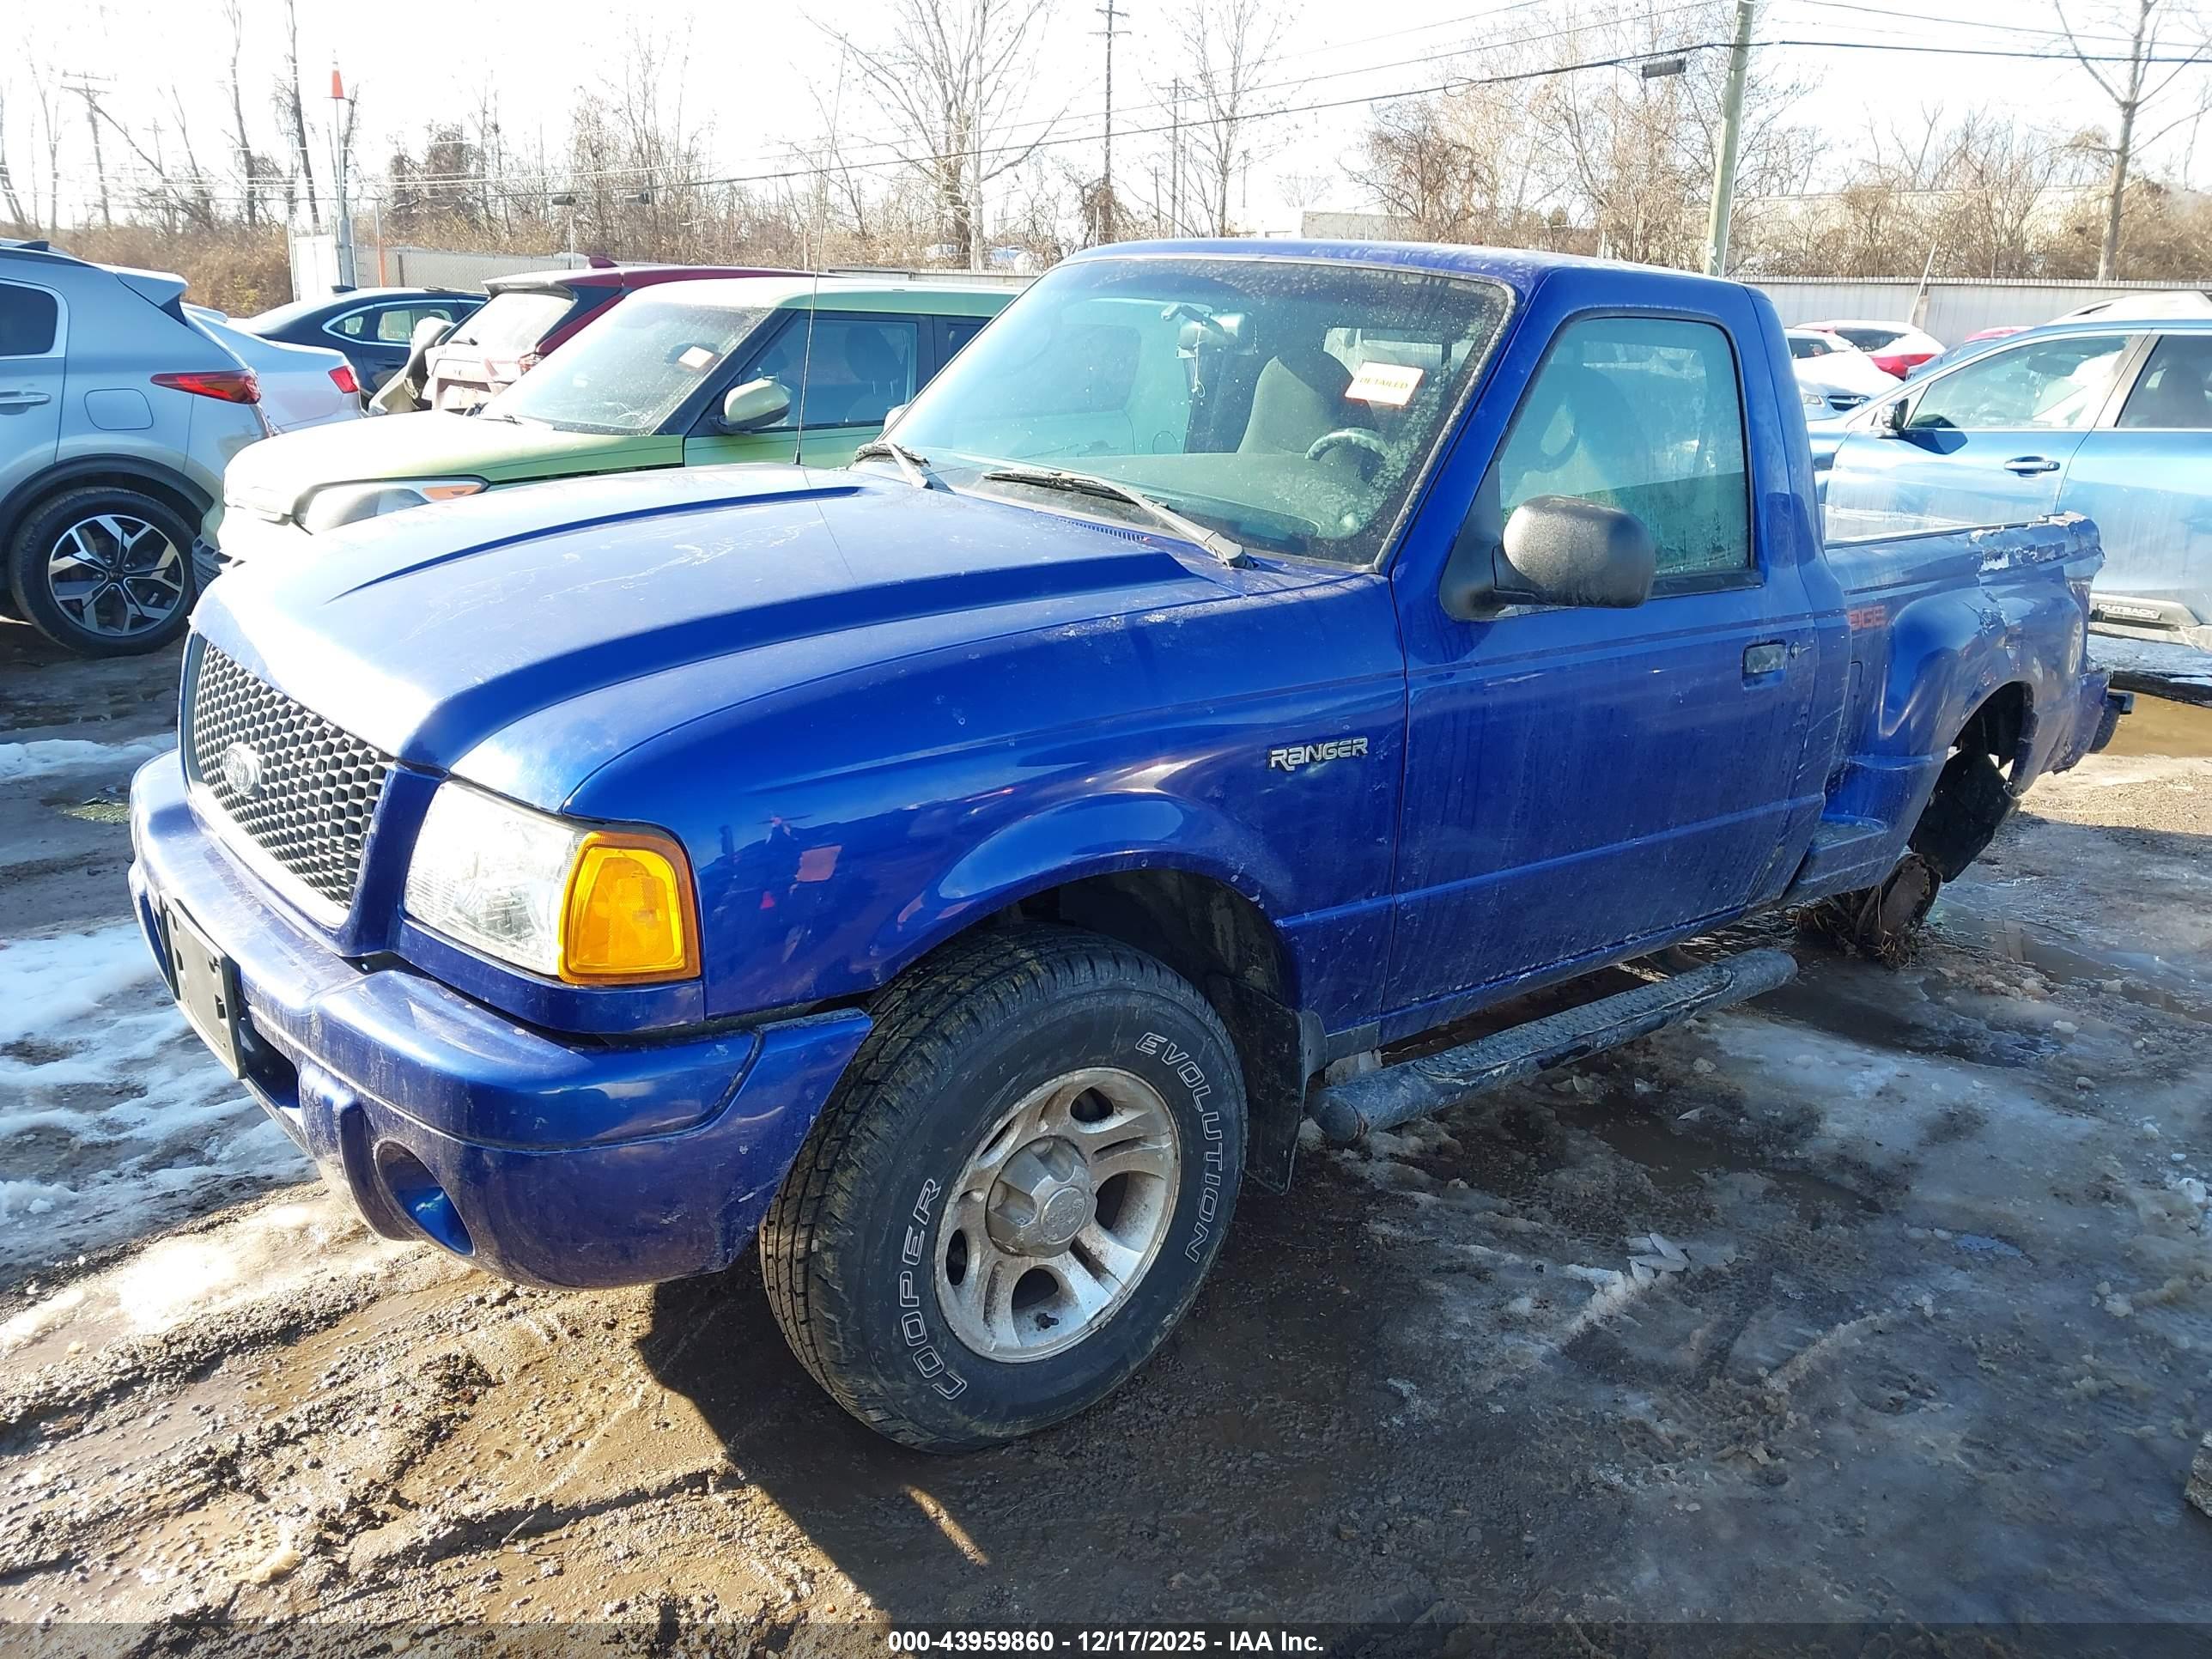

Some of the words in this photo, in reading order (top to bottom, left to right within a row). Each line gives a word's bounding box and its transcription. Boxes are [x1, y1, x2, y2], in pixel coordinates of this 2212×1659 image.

[2098, 604, 2159, 619] OUTBACK
[1270, 738, 1368, 771] RANGER
[1135, 1031, 1223, 1263] EVOLUTION
[899, 1178, 968, 1401] COOPER
